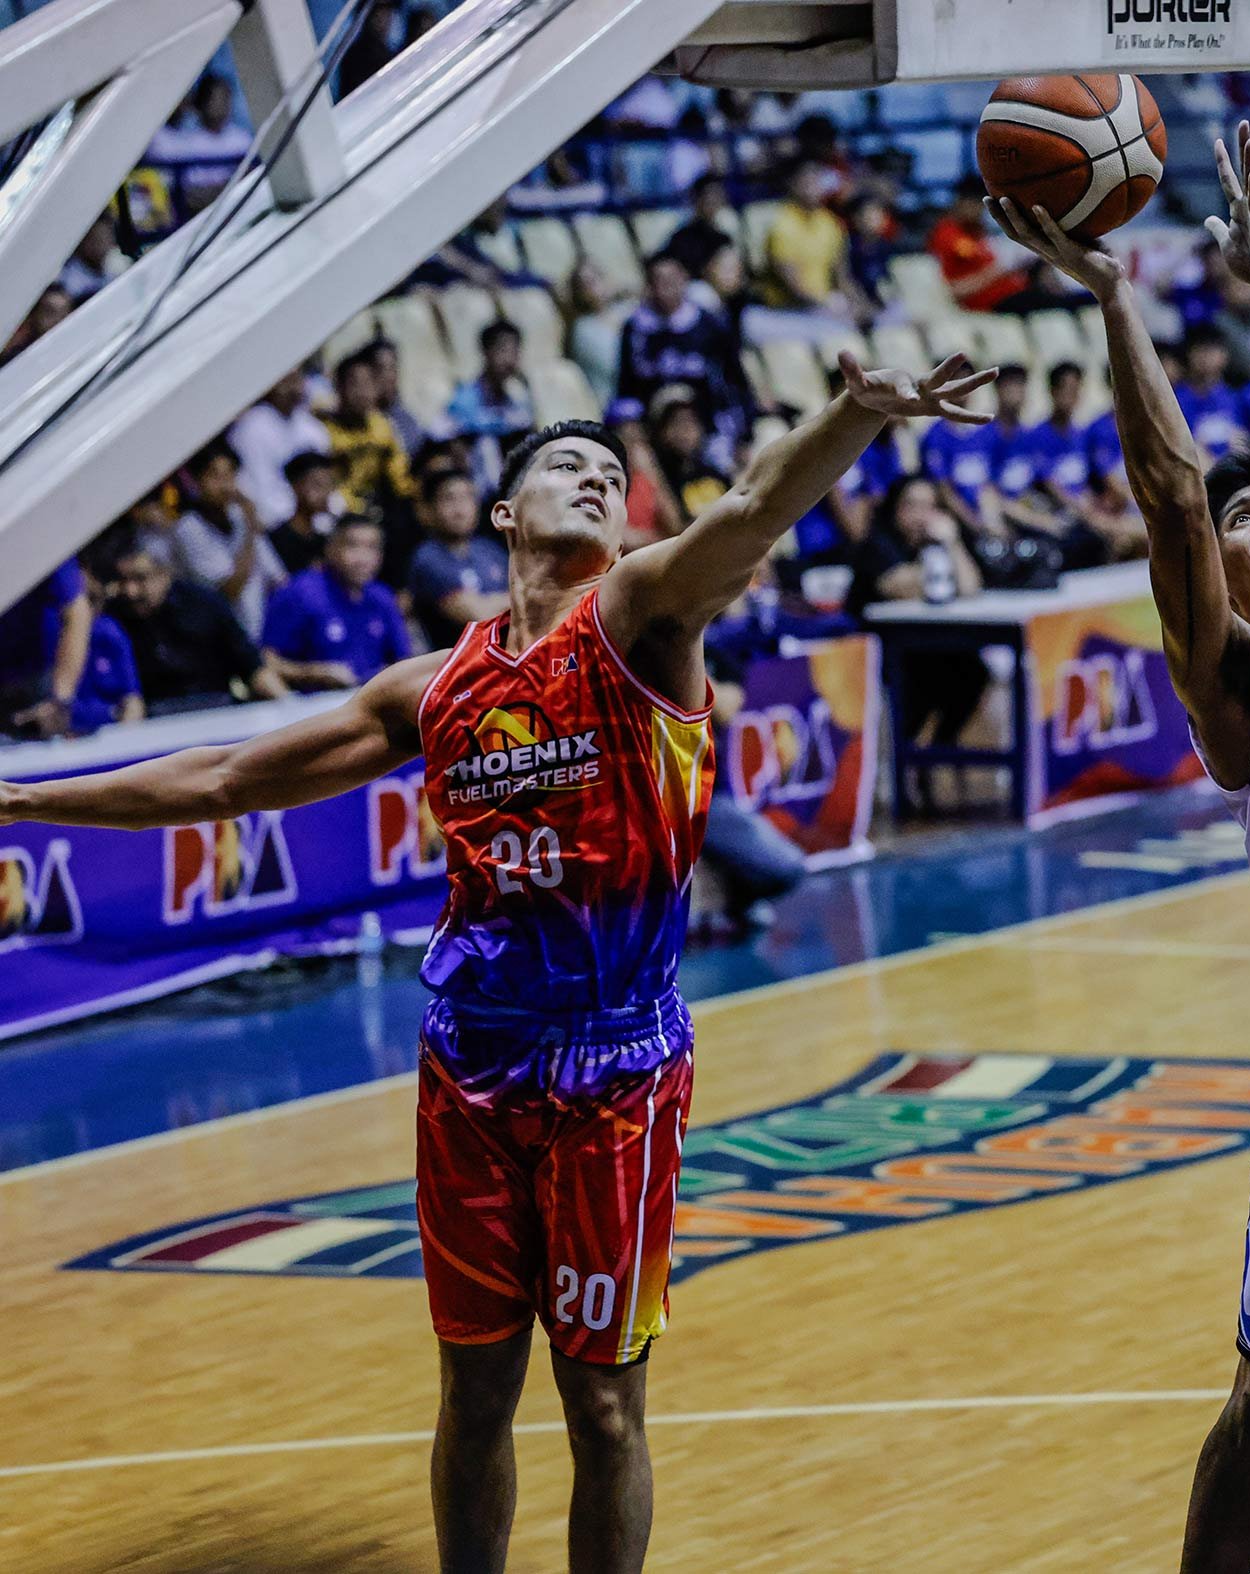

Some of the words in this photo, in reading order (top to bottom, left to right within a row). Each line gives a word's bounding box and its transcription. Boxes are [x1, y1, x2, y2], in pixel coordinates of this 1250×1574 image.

[1130, 34, 1151, 49] What
[1153, 33, 1167, 49] the
[1167, 33, 1186, 49] Pros
[1187, 33, 1205, 53] Play
[491, 826, 564, 895] 20
[556, 1265, 616, 1330] 20
